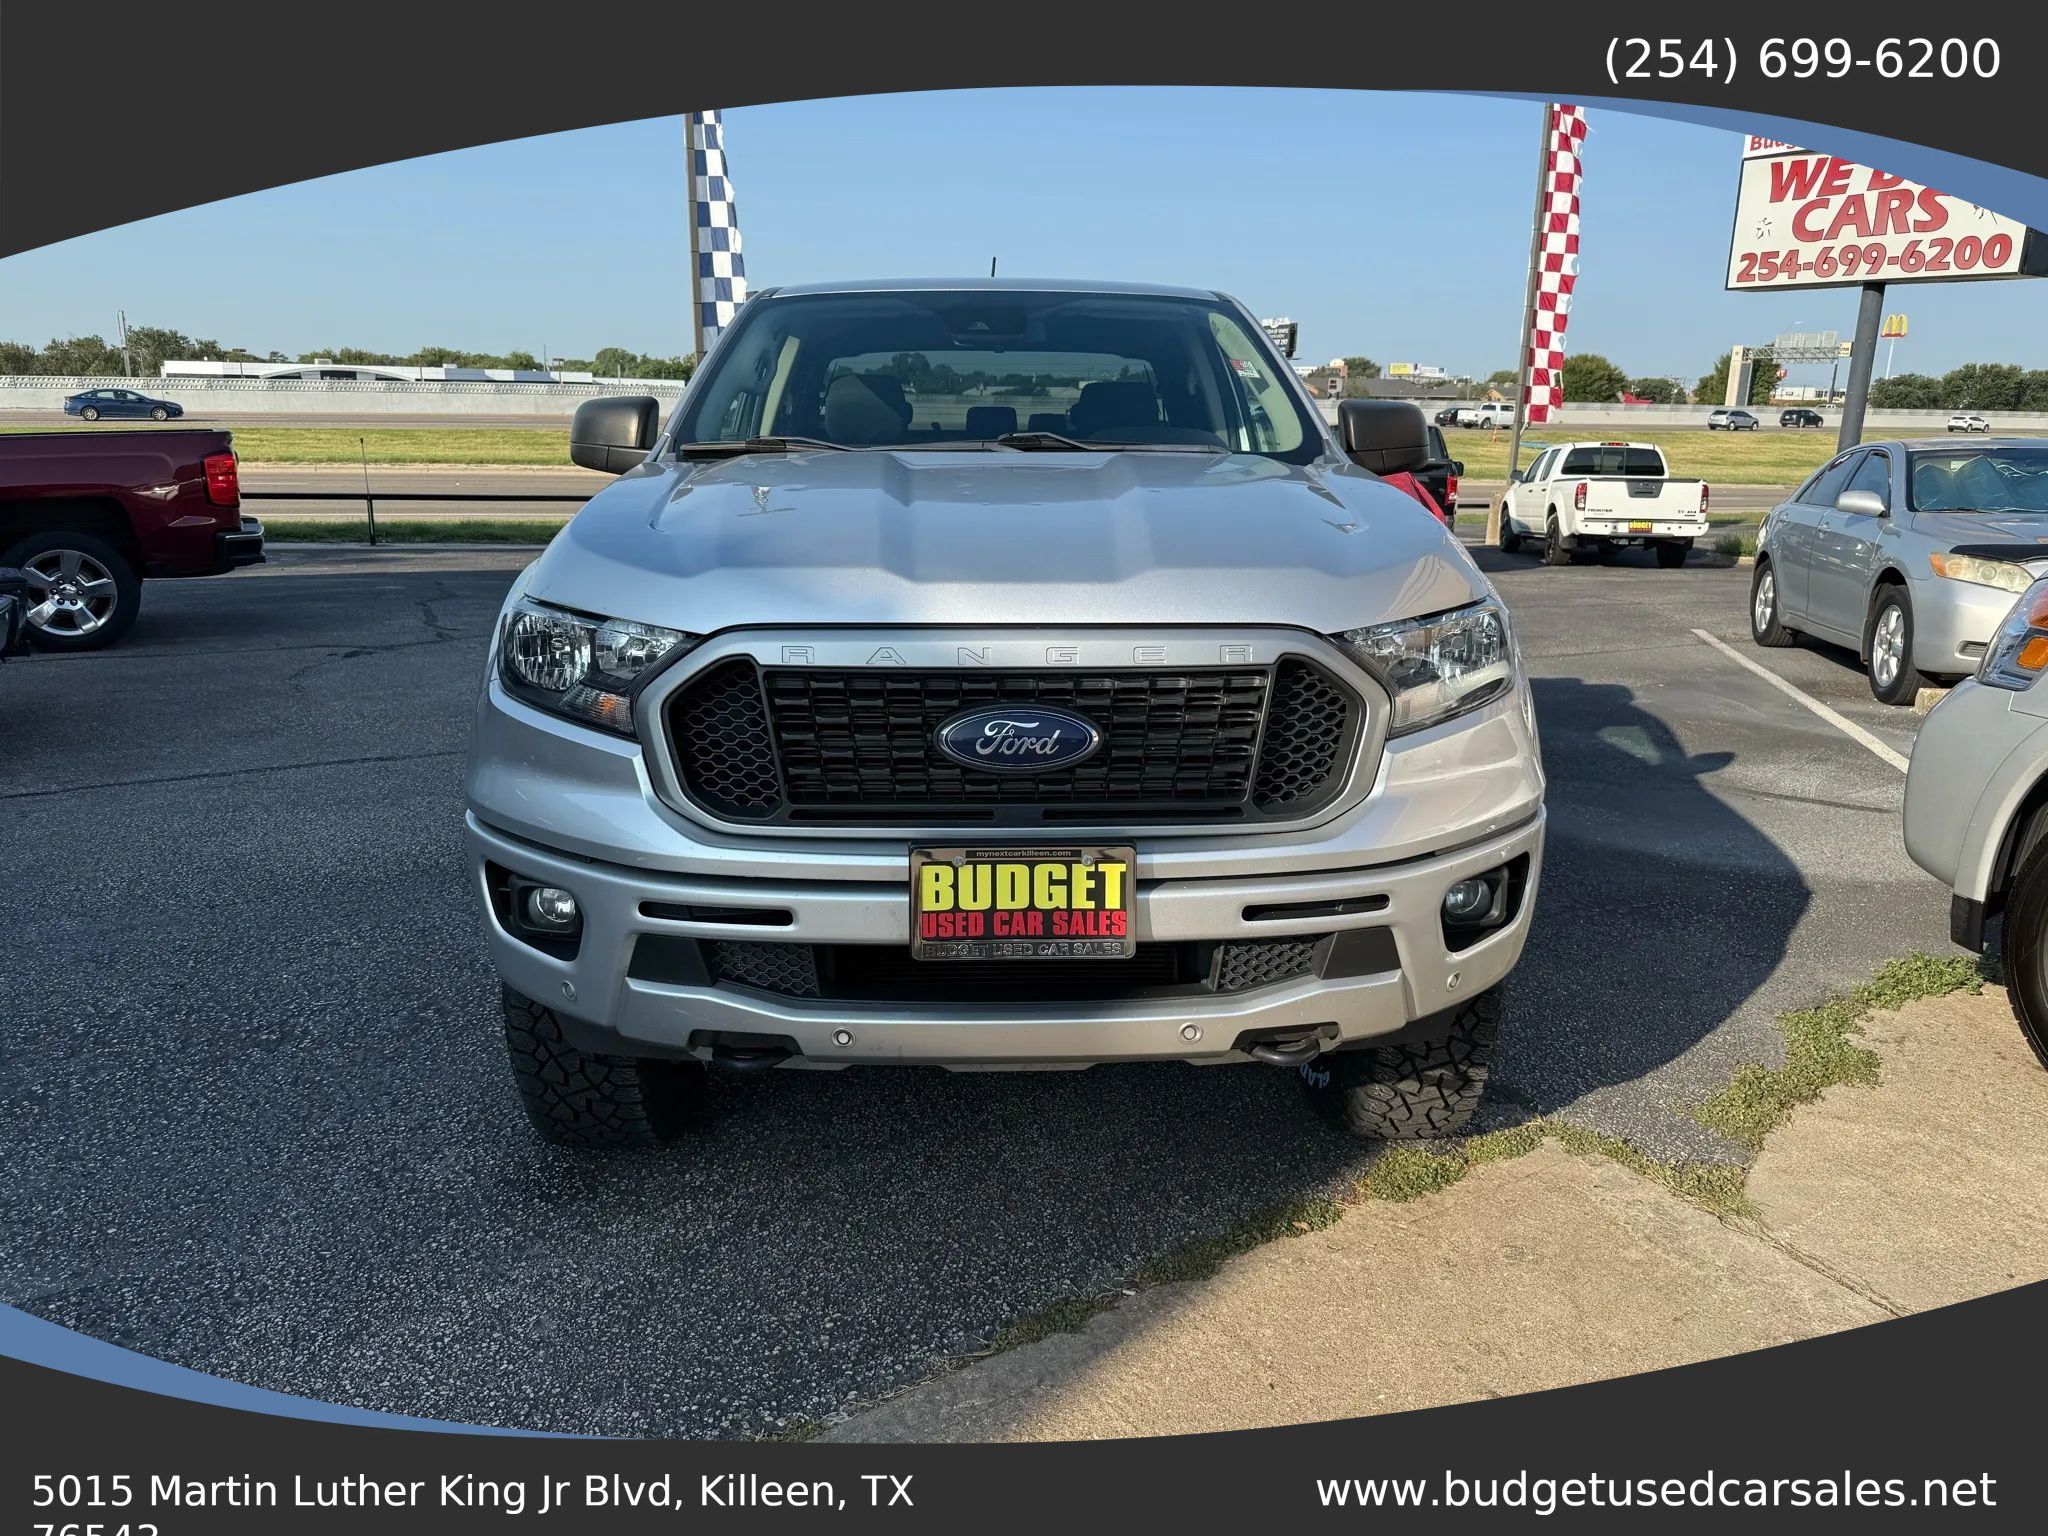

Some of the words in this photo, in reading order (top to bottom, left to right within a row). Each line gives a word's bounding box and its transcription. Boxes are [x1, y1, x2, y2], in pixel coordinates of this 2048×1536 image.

[1769, 157, 1855, 203] WE
[1792, 187, 1951, 242] CARS
[1736, 233, 2013, 283] 254-699-6200
[781, 645, 1253, 665] RANGER
[975, 720, 1060, 755] Ford
[976, 850, 1072, 858] mynextcarkilleen.com
[921, 863, 1127, 911] BUDGET
[921, 912, 984, 937] USED
[993, 911, 1043, 936] CAR
[1052, 911, 1127, 936] SALES
[925, 944, 989, 957] BUDGET
[992, 944, 1034, 956] USED
[1038, 943, 1070, 956] CAR
[1073, 942, 1121, 956] SALES
